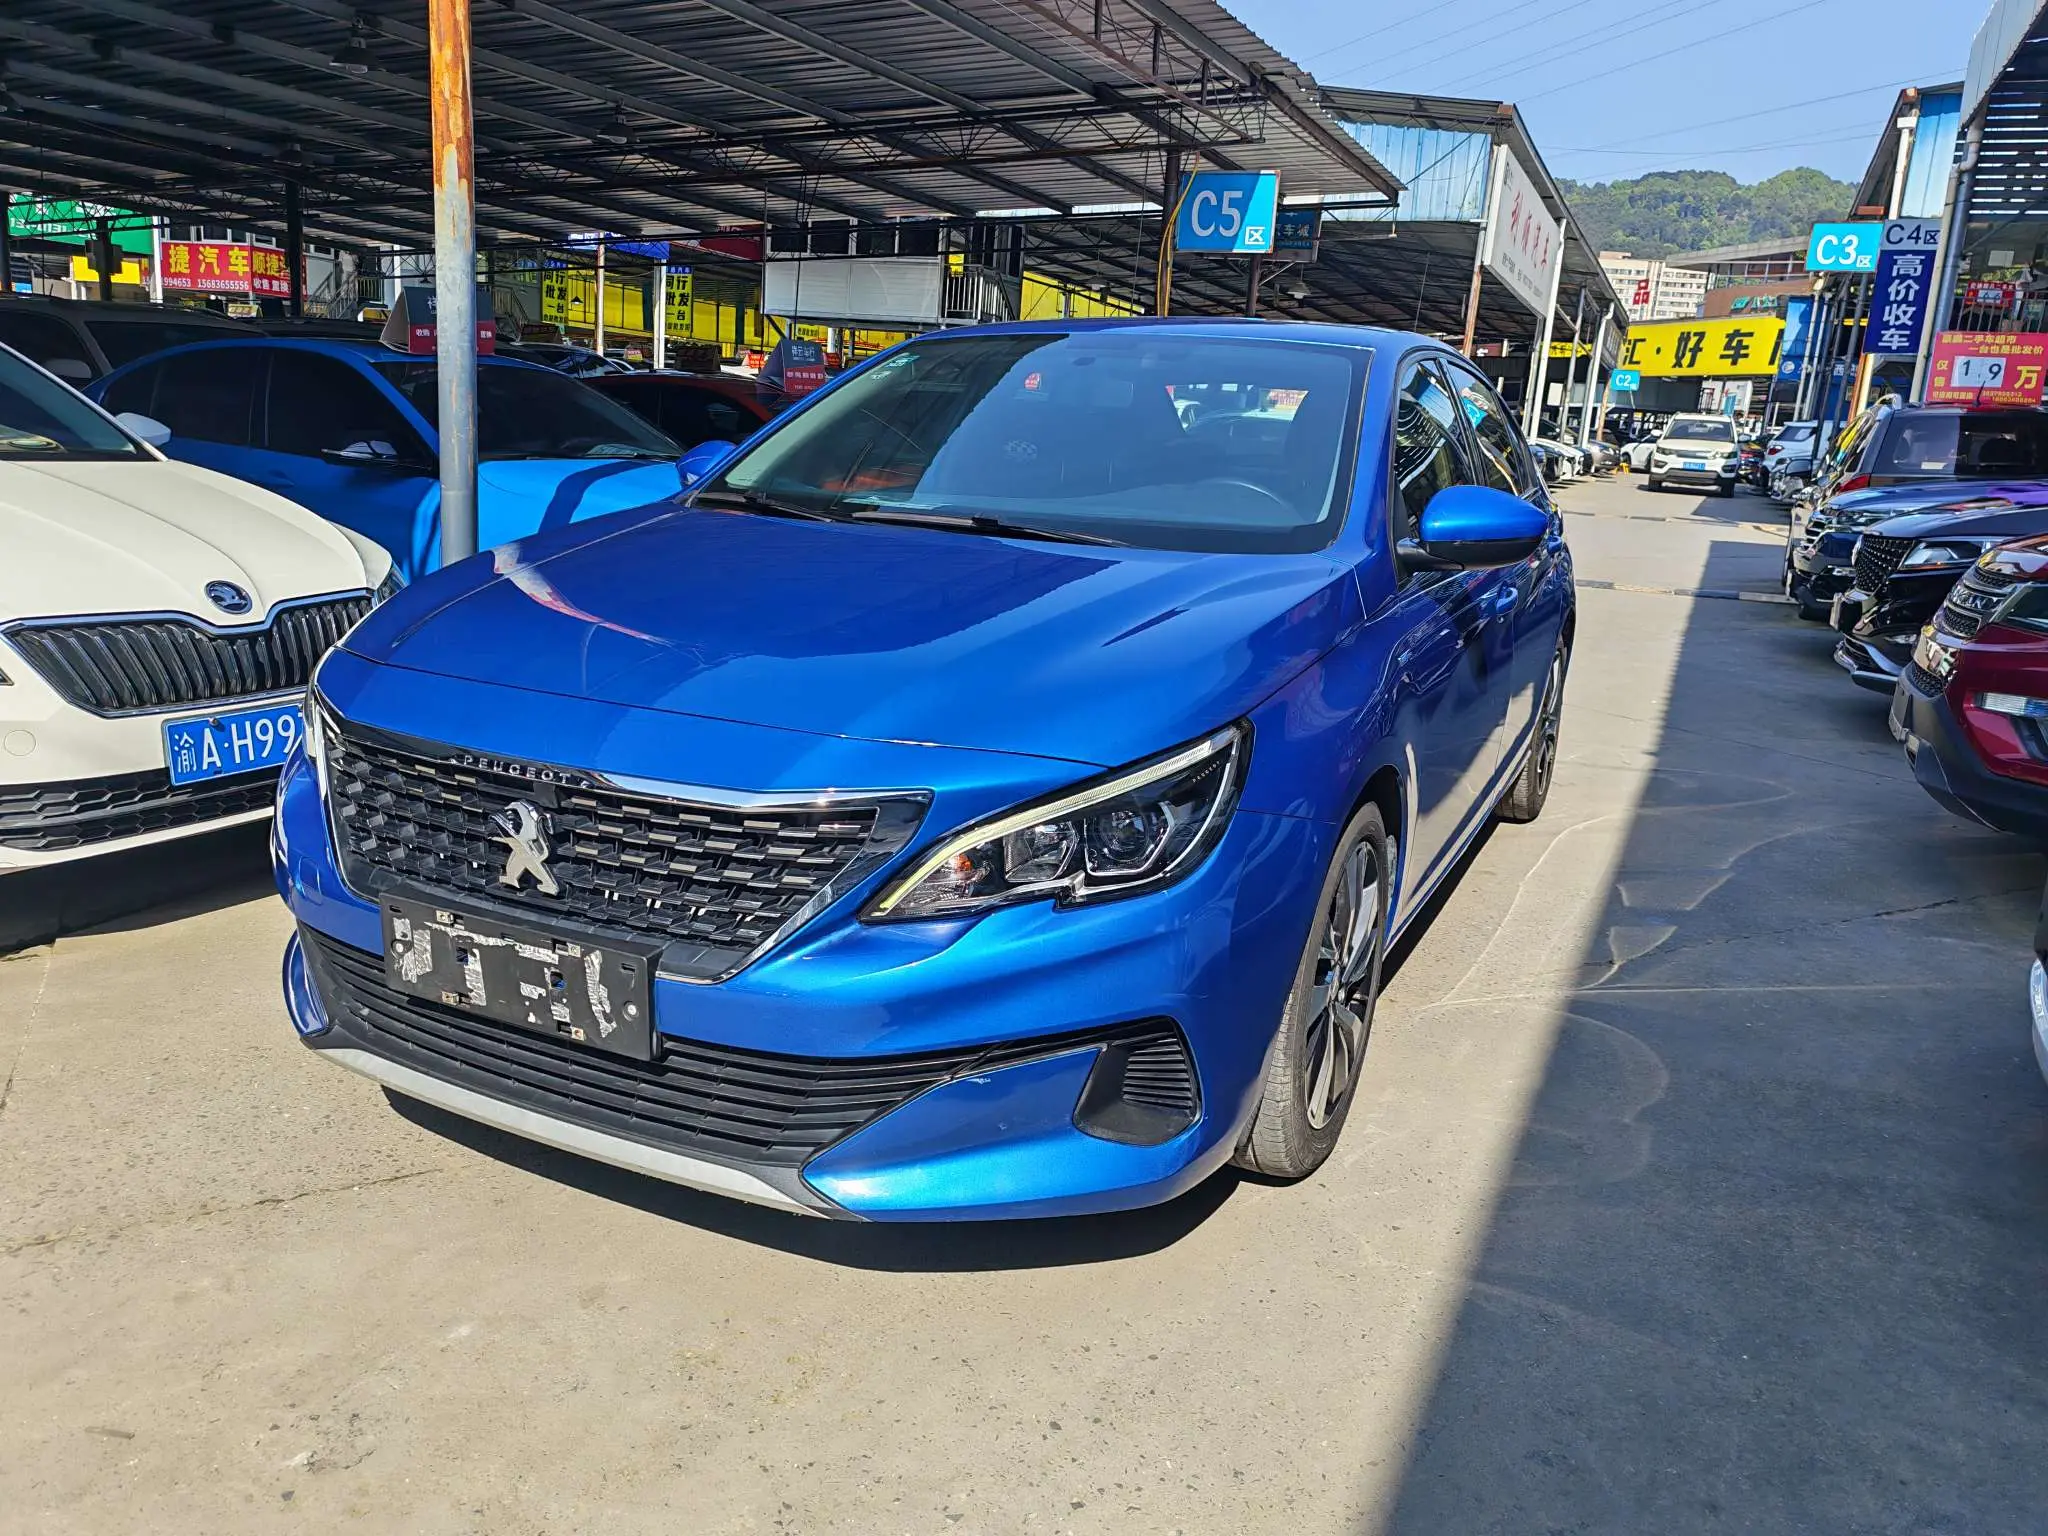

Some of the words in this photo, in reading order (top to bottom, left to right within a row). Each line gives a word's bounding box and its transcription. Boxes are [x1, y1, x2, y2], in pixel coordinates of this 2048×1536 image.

[1191, 190, 1266, 245] C5区
[1885, 223, 1940, 245] C4区
[1816, 234, 1872, 268] C3区
[1877, 254, 1925, 350] 高价收车
[1622, 329, 1785, 369] 汇·好车
[2014, 365, 2042, 390] 万
[174, 713, 302, 774] 渝A·H99
[464, 754, 570, 784] PEUGEOT
